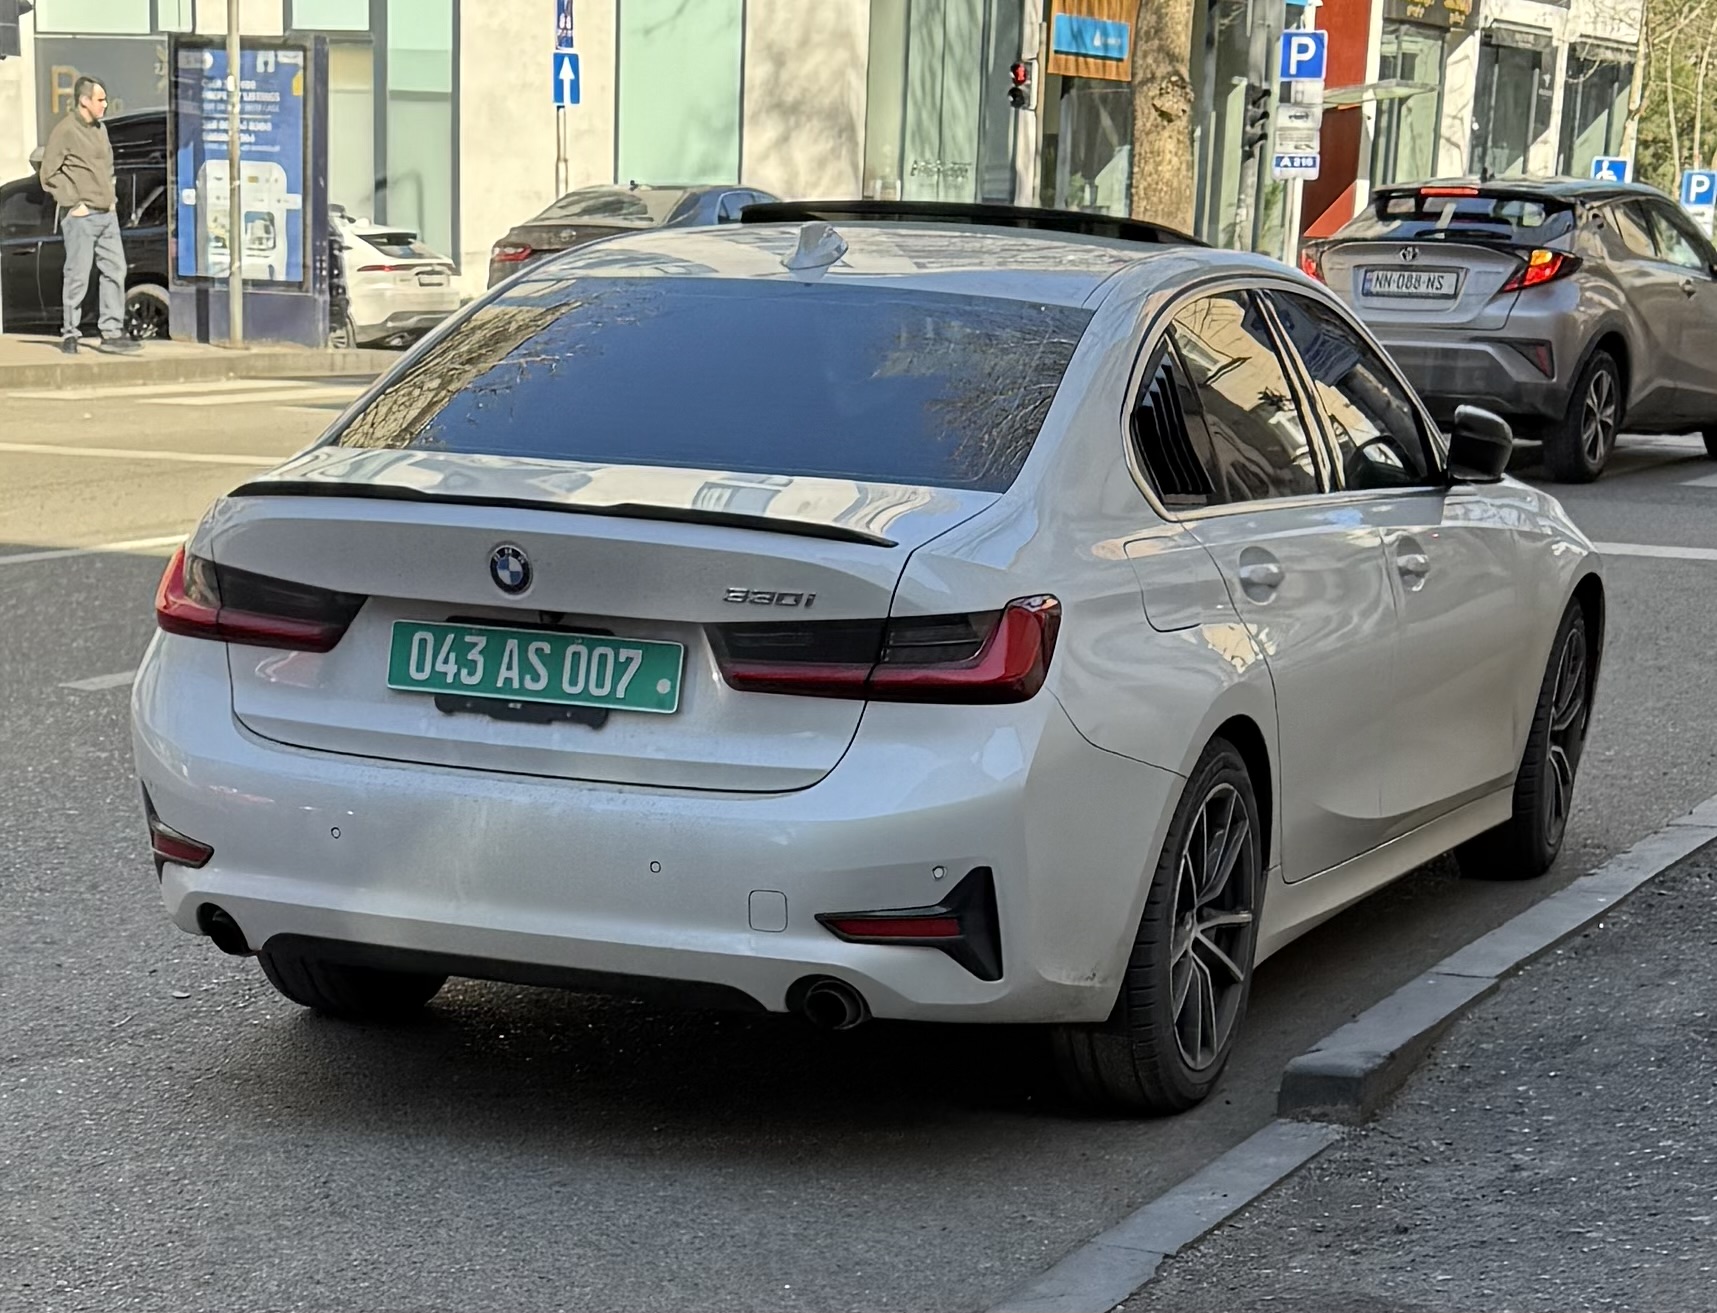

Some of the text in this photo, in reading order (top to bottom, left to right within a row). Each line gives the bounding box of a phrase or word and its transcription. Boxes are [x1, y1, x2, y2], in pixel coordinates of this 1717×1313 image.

[1289, 36, 1316, 75] P
[1689, 175, 1711, 202] P
[722, 587, 816, 608] 330i
[408, 631, 643, 699] 043 AS 007
